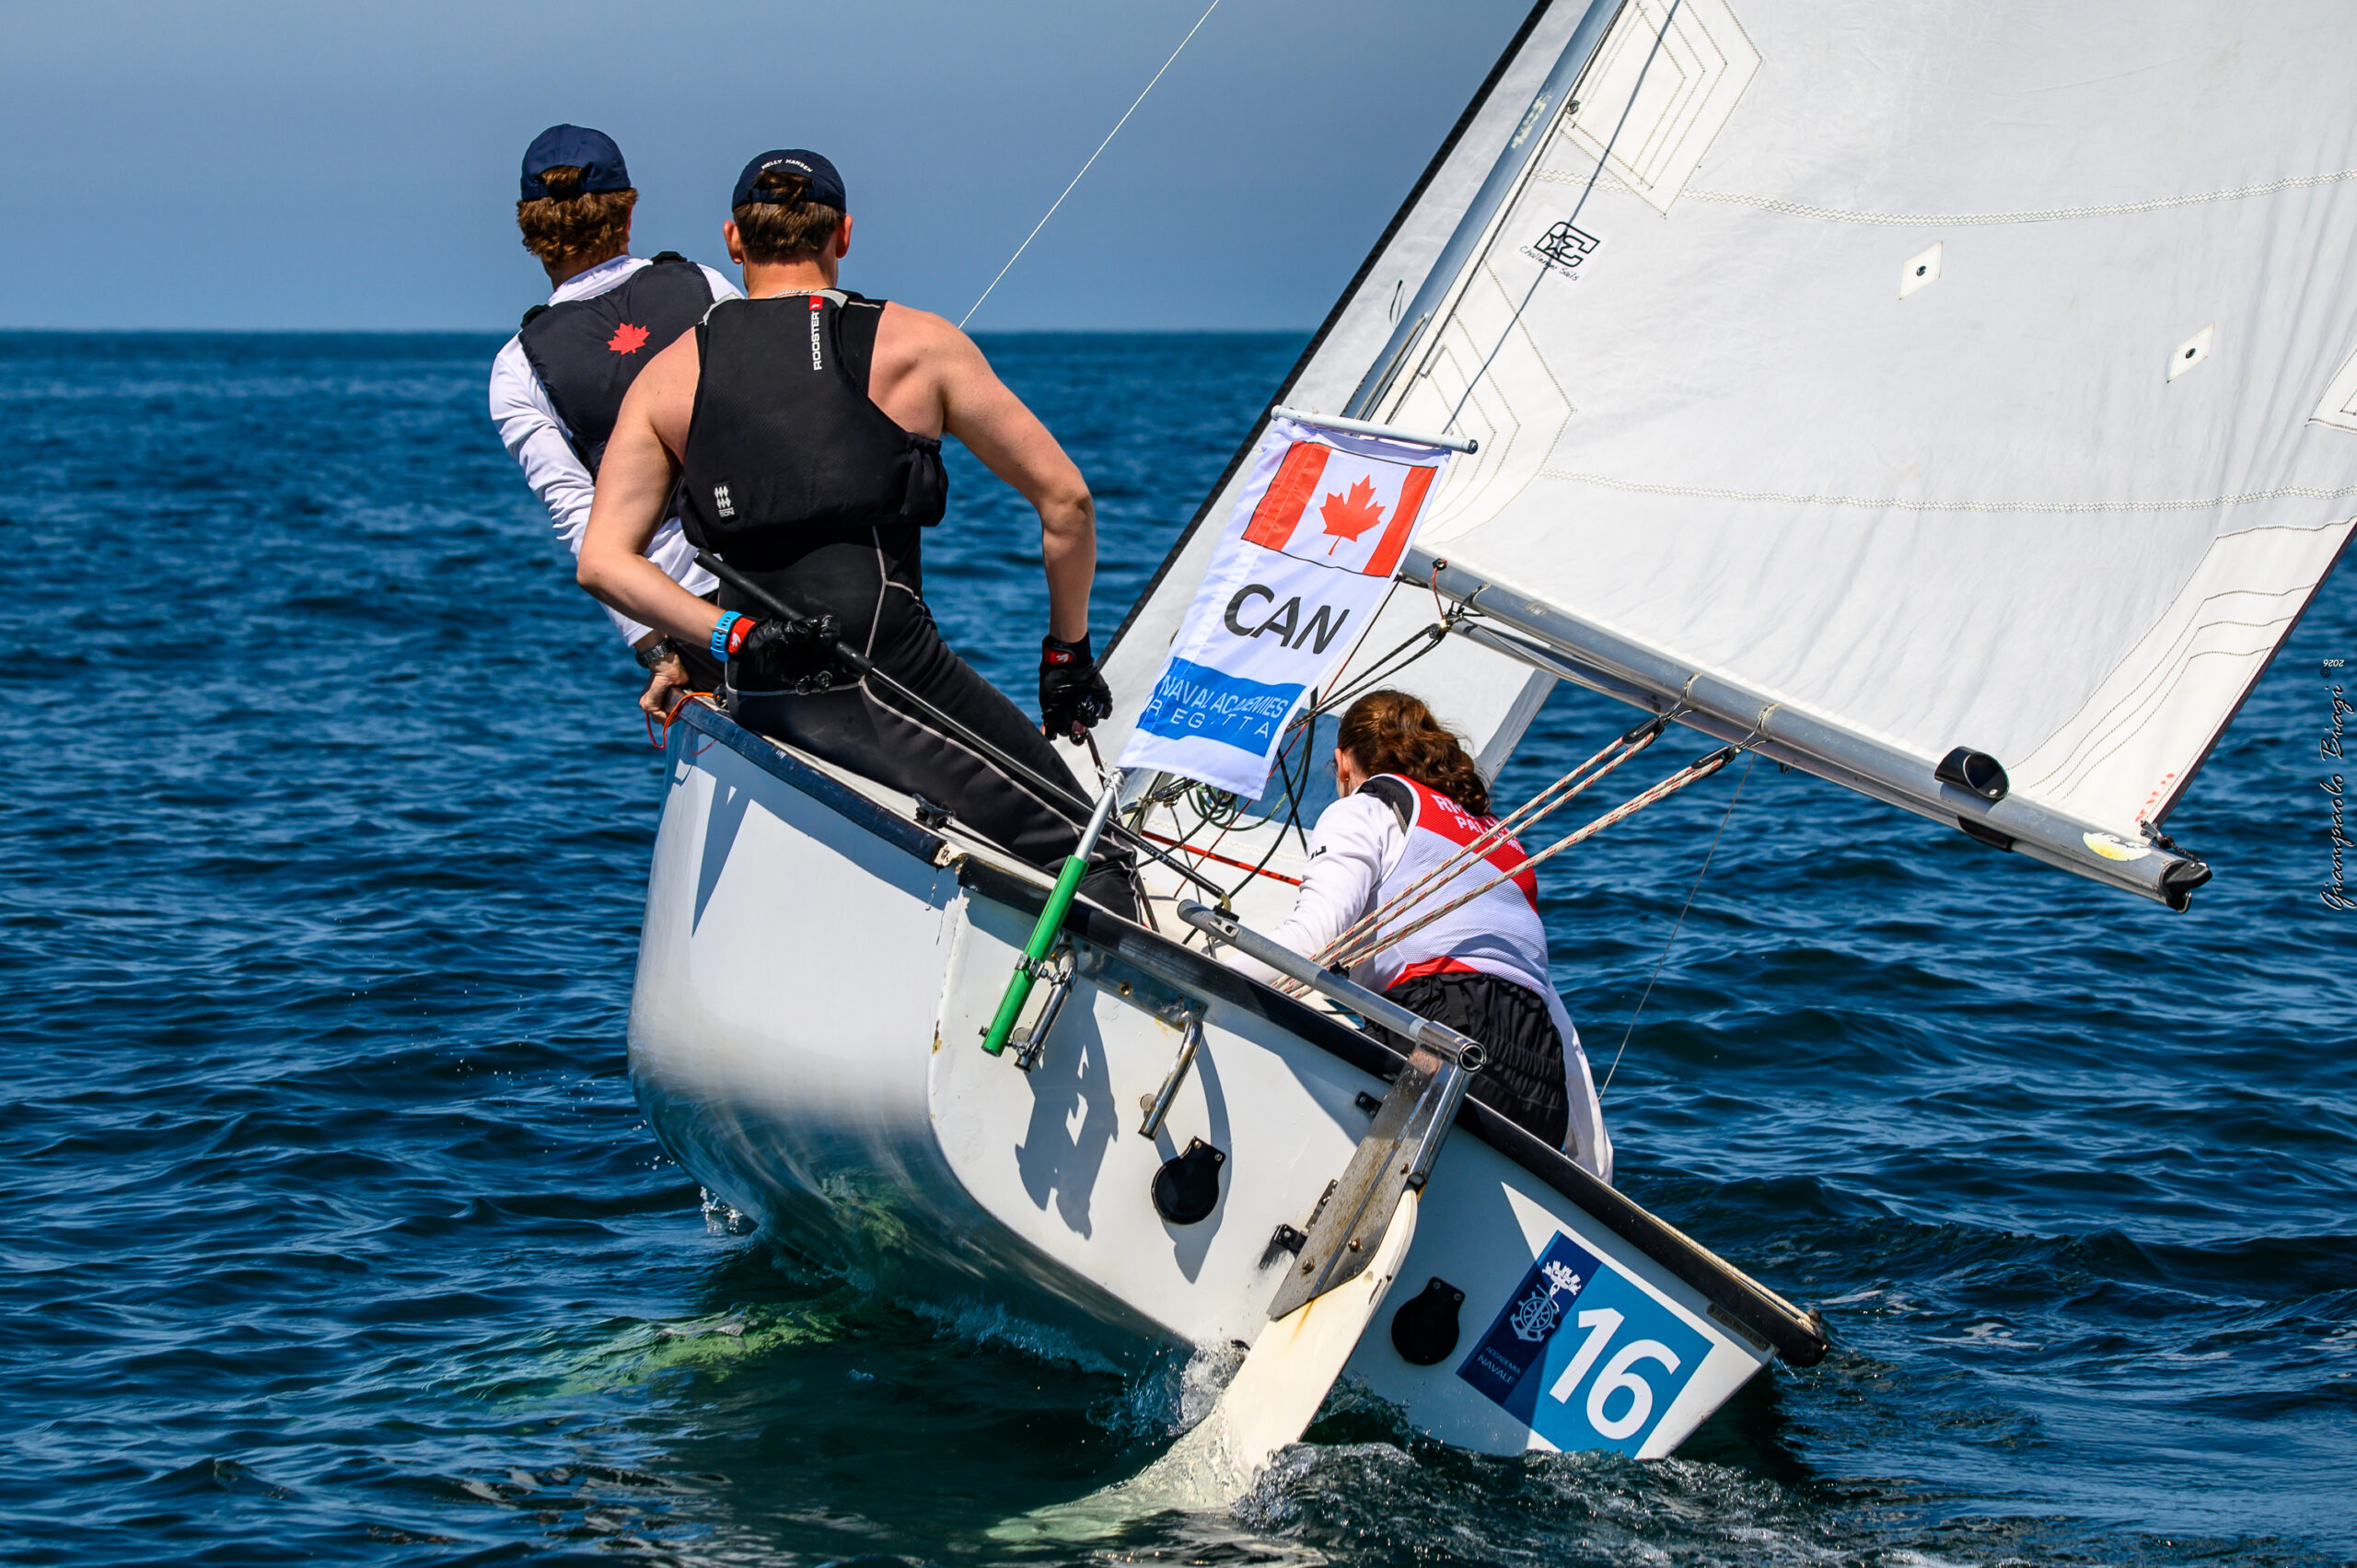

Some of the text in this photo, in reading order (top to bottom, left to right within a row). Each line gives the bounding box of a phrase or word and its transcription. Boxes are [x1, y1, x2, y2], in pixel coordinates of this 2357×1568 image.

[810, 310, 823, 371] ROOSTER
[1224, 583, 1351, 655] CAN
[1159, 675, 1214, 709] NAVAL
[1145, 699, 1270, 738] REGTTA
[1477, 1354, 1515, 1385] NAVALE
[1549, 1307, 1681, 1440] 16
